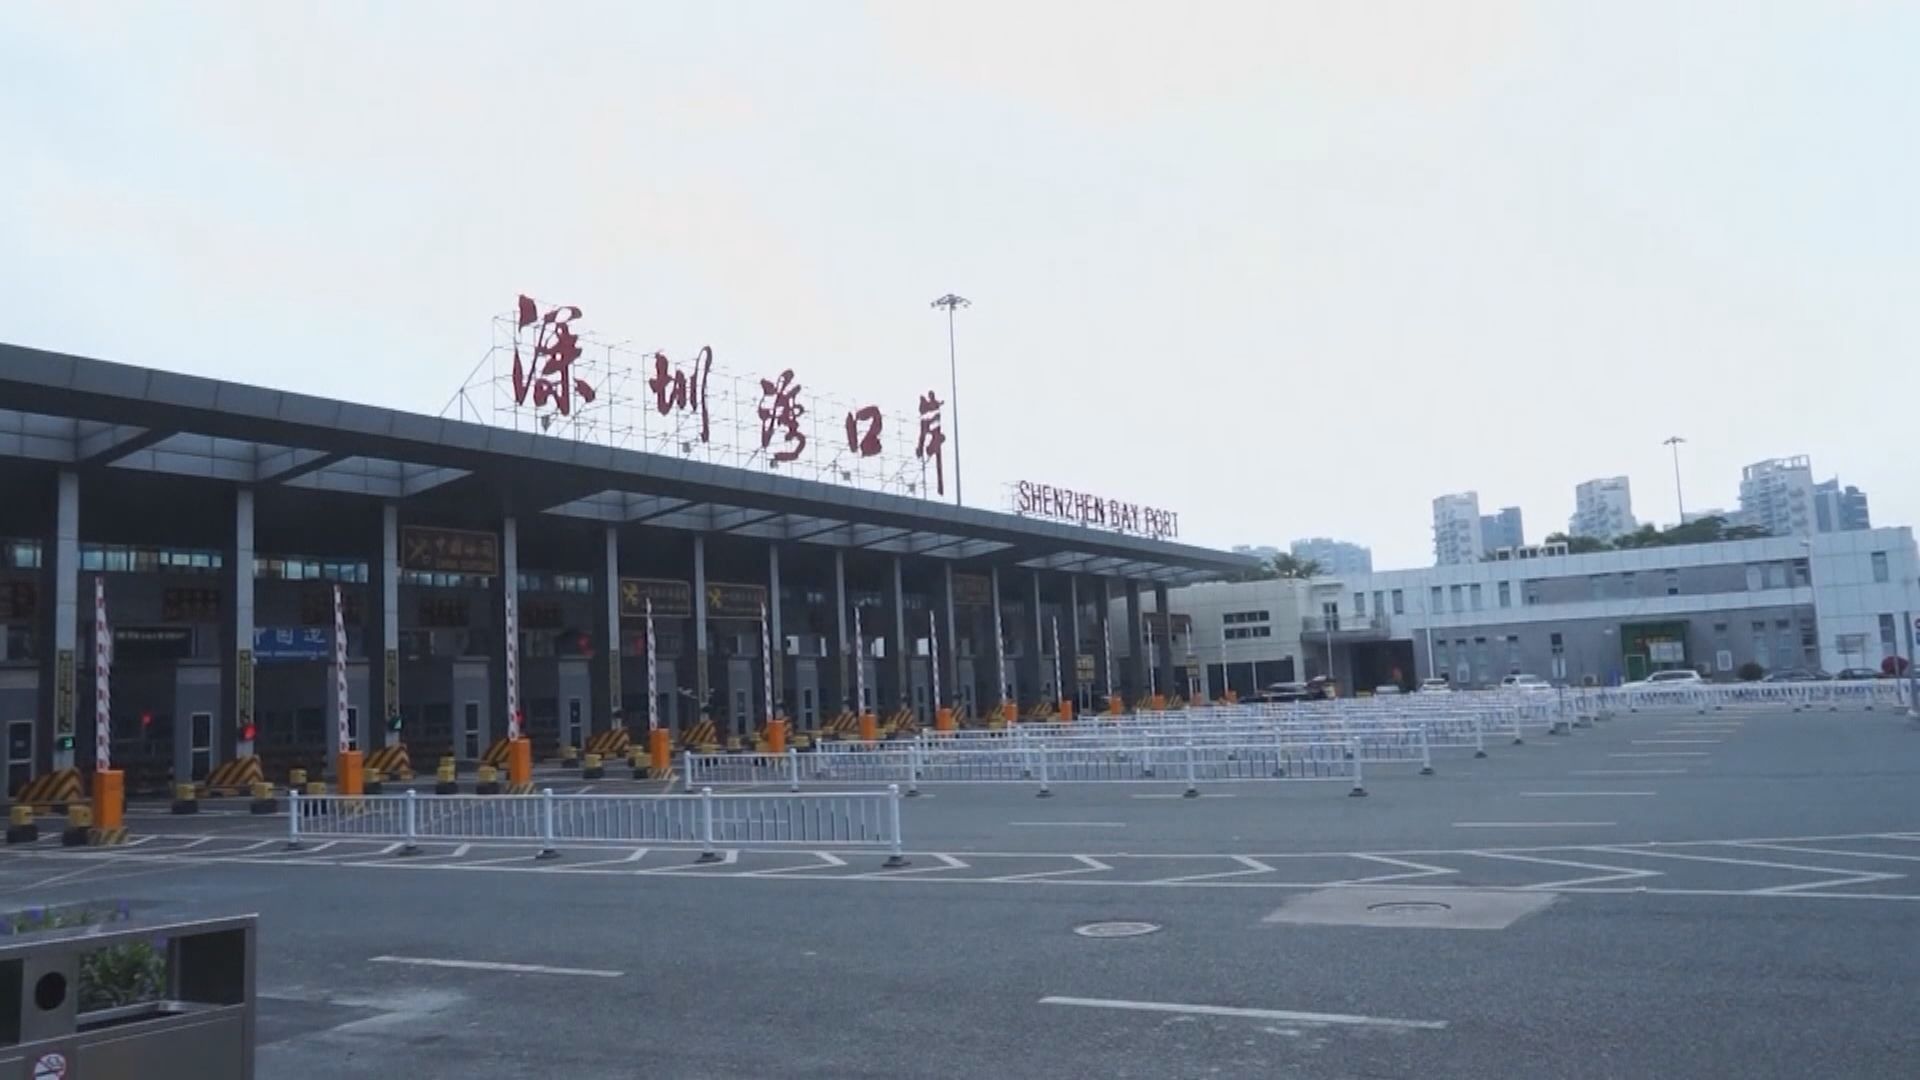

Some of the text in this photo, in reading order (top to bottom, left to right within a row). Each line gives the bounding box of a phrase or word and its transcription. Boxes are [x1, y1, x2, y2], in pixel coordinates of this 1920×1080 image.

[513, 294, 946, 495] 深圳湾口岸
[1019, 480, 1179, 538] SHENZHEN BAY PORT
